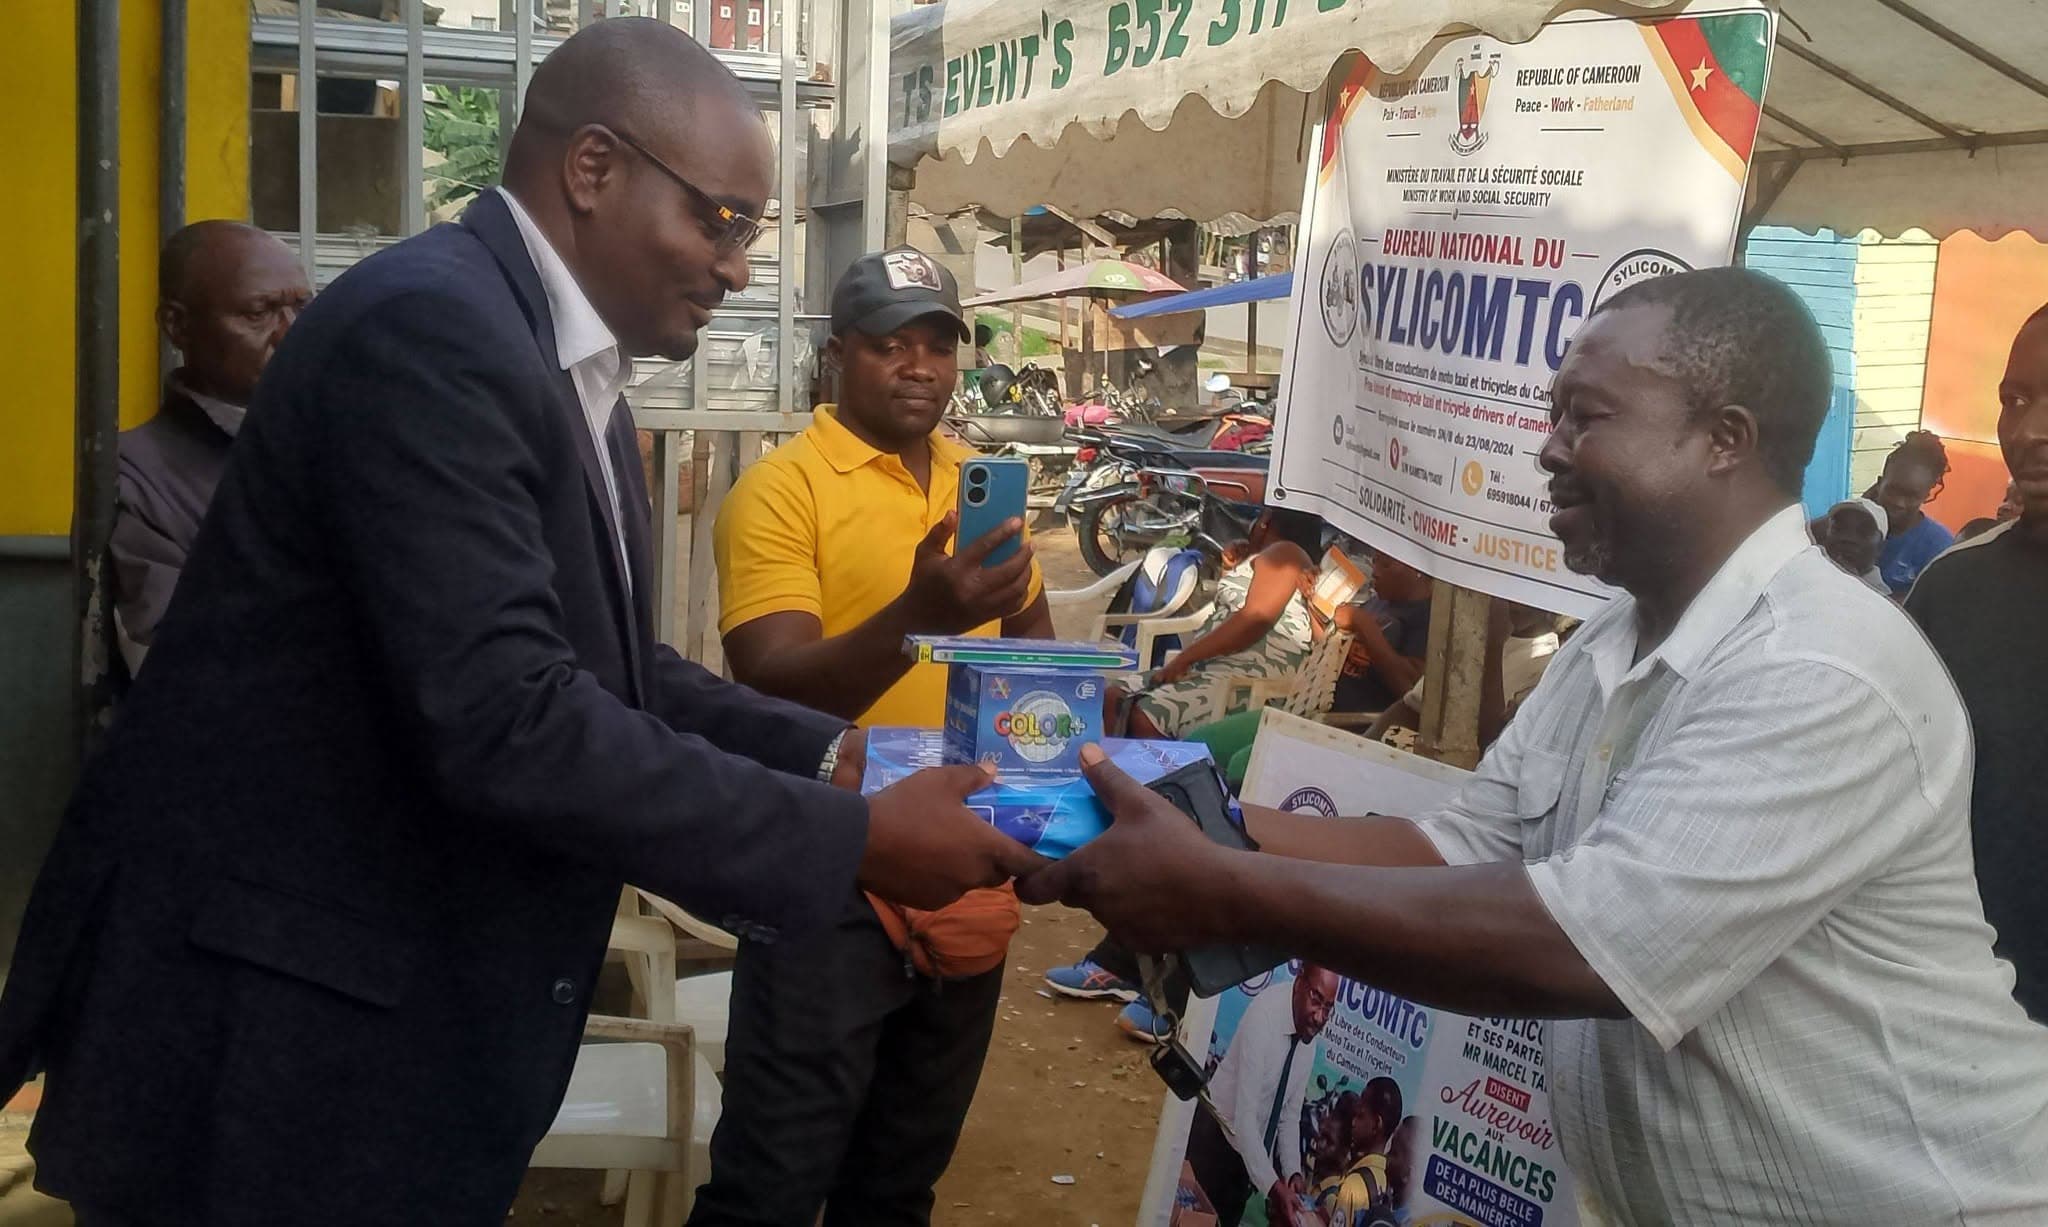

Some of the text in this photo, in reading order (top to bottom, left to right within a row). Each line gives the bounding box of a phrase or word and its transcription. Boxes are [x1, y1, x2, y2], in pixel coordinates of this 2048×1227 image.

[1104, 0, 1190, 76] 652
[1516, 64, 1641, 87] REPUBLIC OF CAMEROON
[1515, 97, 1542, 112] Peace
[1551, 96, 1575, 112] Work
[1584, 95, 1634, 111] Fatherland
[1467, 168, 1477, 183] DE
[1478, 169, 1490, 183] LA
[1491, 164, 1538, 185] SÉCURITÉ
[1539, 169, 1584, 186] SOCIALE
[1472, 190, 1501, 204] SOCIAL
[1503, 191, 1552, 208] SECURITY
[1383, 229, 1566, 270] BUREAU NATIONAL DU
[1360, 262, 1584, 372] SYLICOMTC
[1454, 372, 1470, 388] taxi
[1470, 376, 1479, 390] et
[1480, 377, 1518, 397] tricycles
[1520, 383, 1531, 399] du
[1443, 398, 1471, 418] tricycle
[1472, 403, 1505, 425] drivers
[1506, 411, 1518, 428] of
[1454, 432, 1464, 445] du
[1465, 434, 1514, 456] 23/08/2024
[1486, 487, 1531, 508] 695918044
[1359, 485, 1406, 525] SOLIDARITÉ
[1413, 510, 1458, 547] CIVISME
[1473, 532, 1558, 573] JUSTICE
[1334, 1013, 1353, 1033] Libre
[1352, 1024, 1365, 1041] des
[1365, 1032, 1407, 1065] Conducteurs
[1467, 1022, 1482, 1040] ET
[1482, 1029, 1504, 1049] SES
[1326, 1048, 1370, 1081] du Cameroun
[1341, 1036, 1357, 1054] Taxi
[1364, 1051, 1393, 1075] Tricycles
[1462, 1041, 1481, 1063] MR
[1482, 1050, 1527, 1084] MARCEL
[1489, 1082, 1526, 1108] DISENT
[1440, 1079, 1554, 1150] Aurevoir
[1485, 1127, 1505, 1144] AUX
[1432, 1115, 1557, 1203] VACANCES
[1435, 1160, 1534, 1222] DE LA PLUS BELLE
[1435, 1181, 1458, 1204] DES
